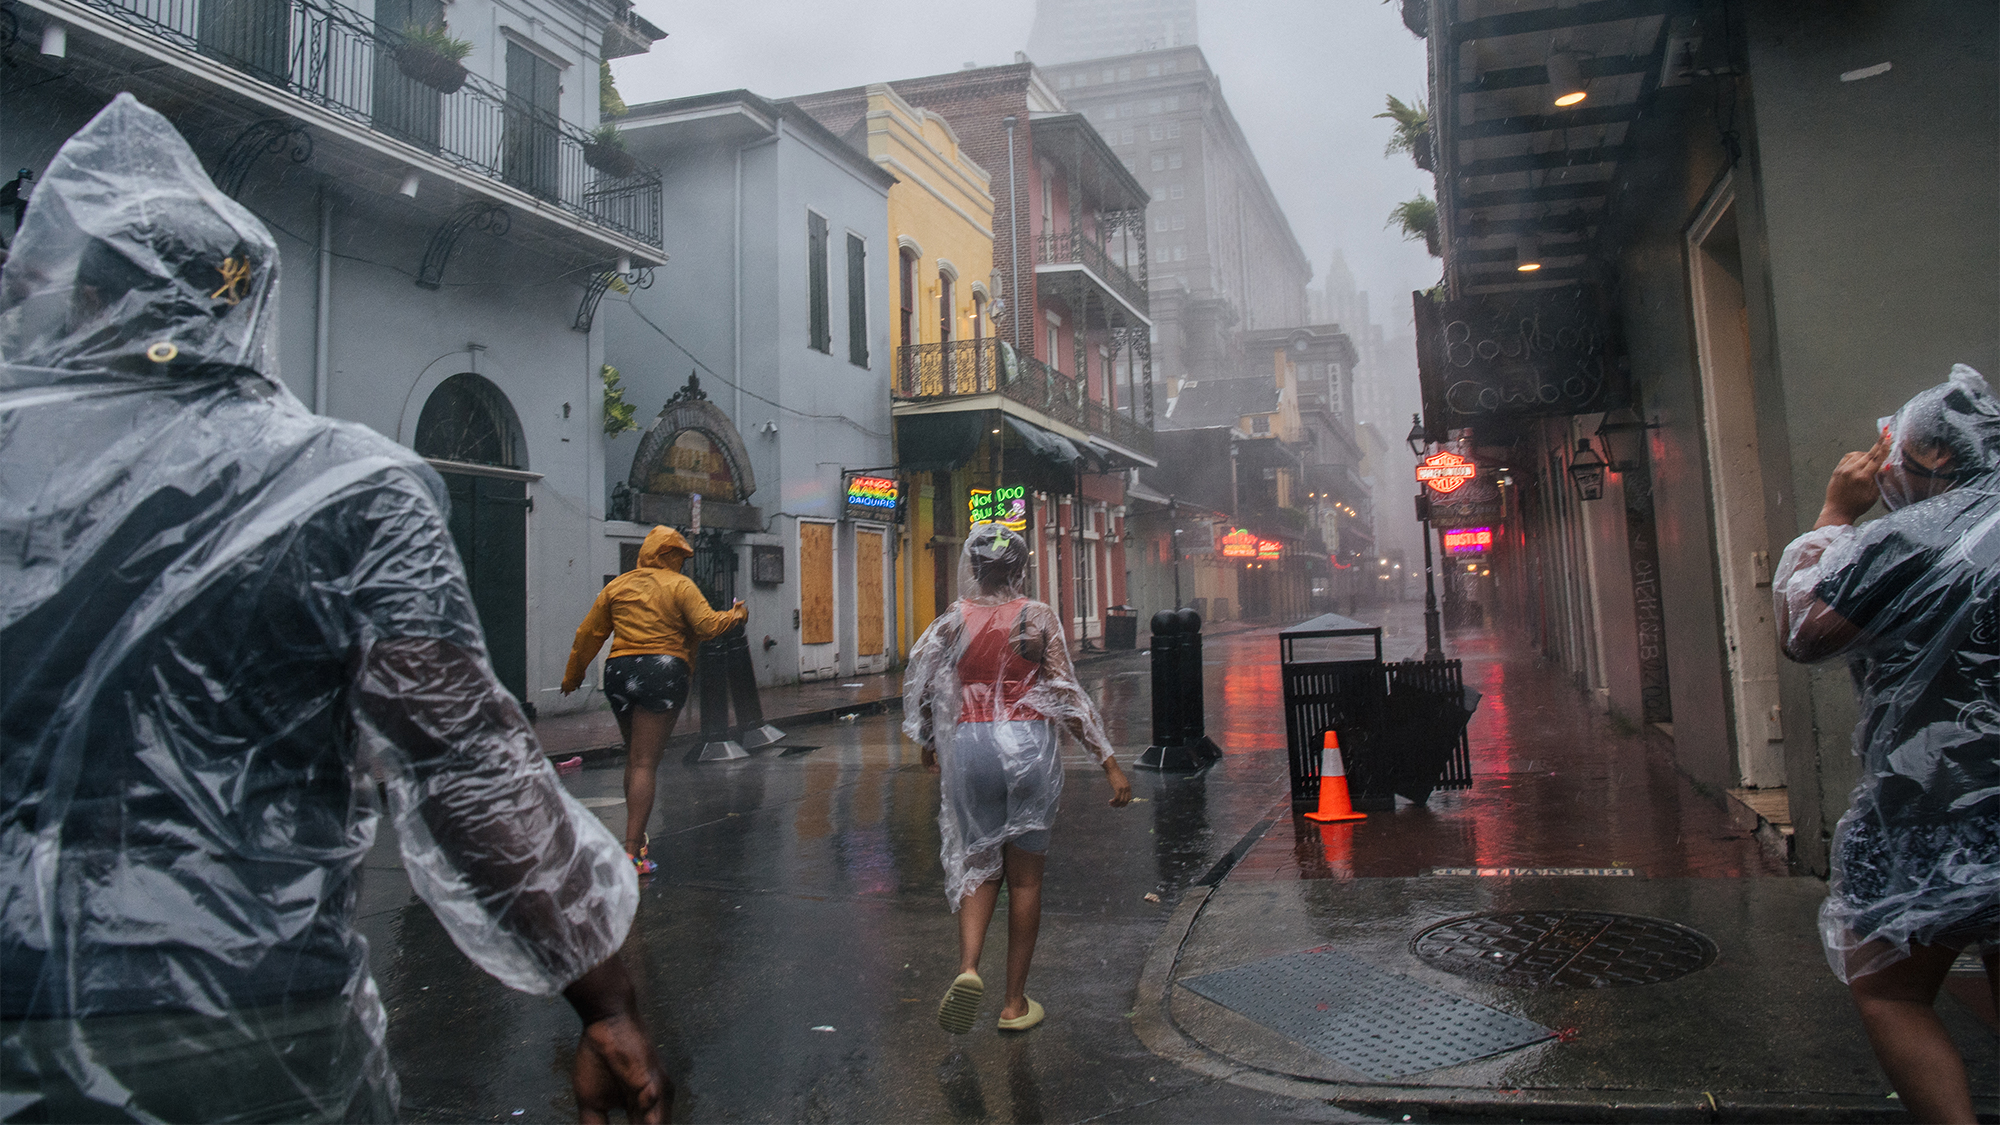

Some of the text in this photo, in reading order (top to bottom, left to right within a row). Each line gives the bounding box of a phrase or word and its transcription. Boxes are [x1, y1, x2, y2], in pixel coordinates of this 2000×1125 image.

[1446, 356, 1604, 414] Cowboy
[855, 478, 892, 489] MANGO
[849, 495, 896, 508] DAIQUIRIS
[971, 502, 1005, 521] BLUS
